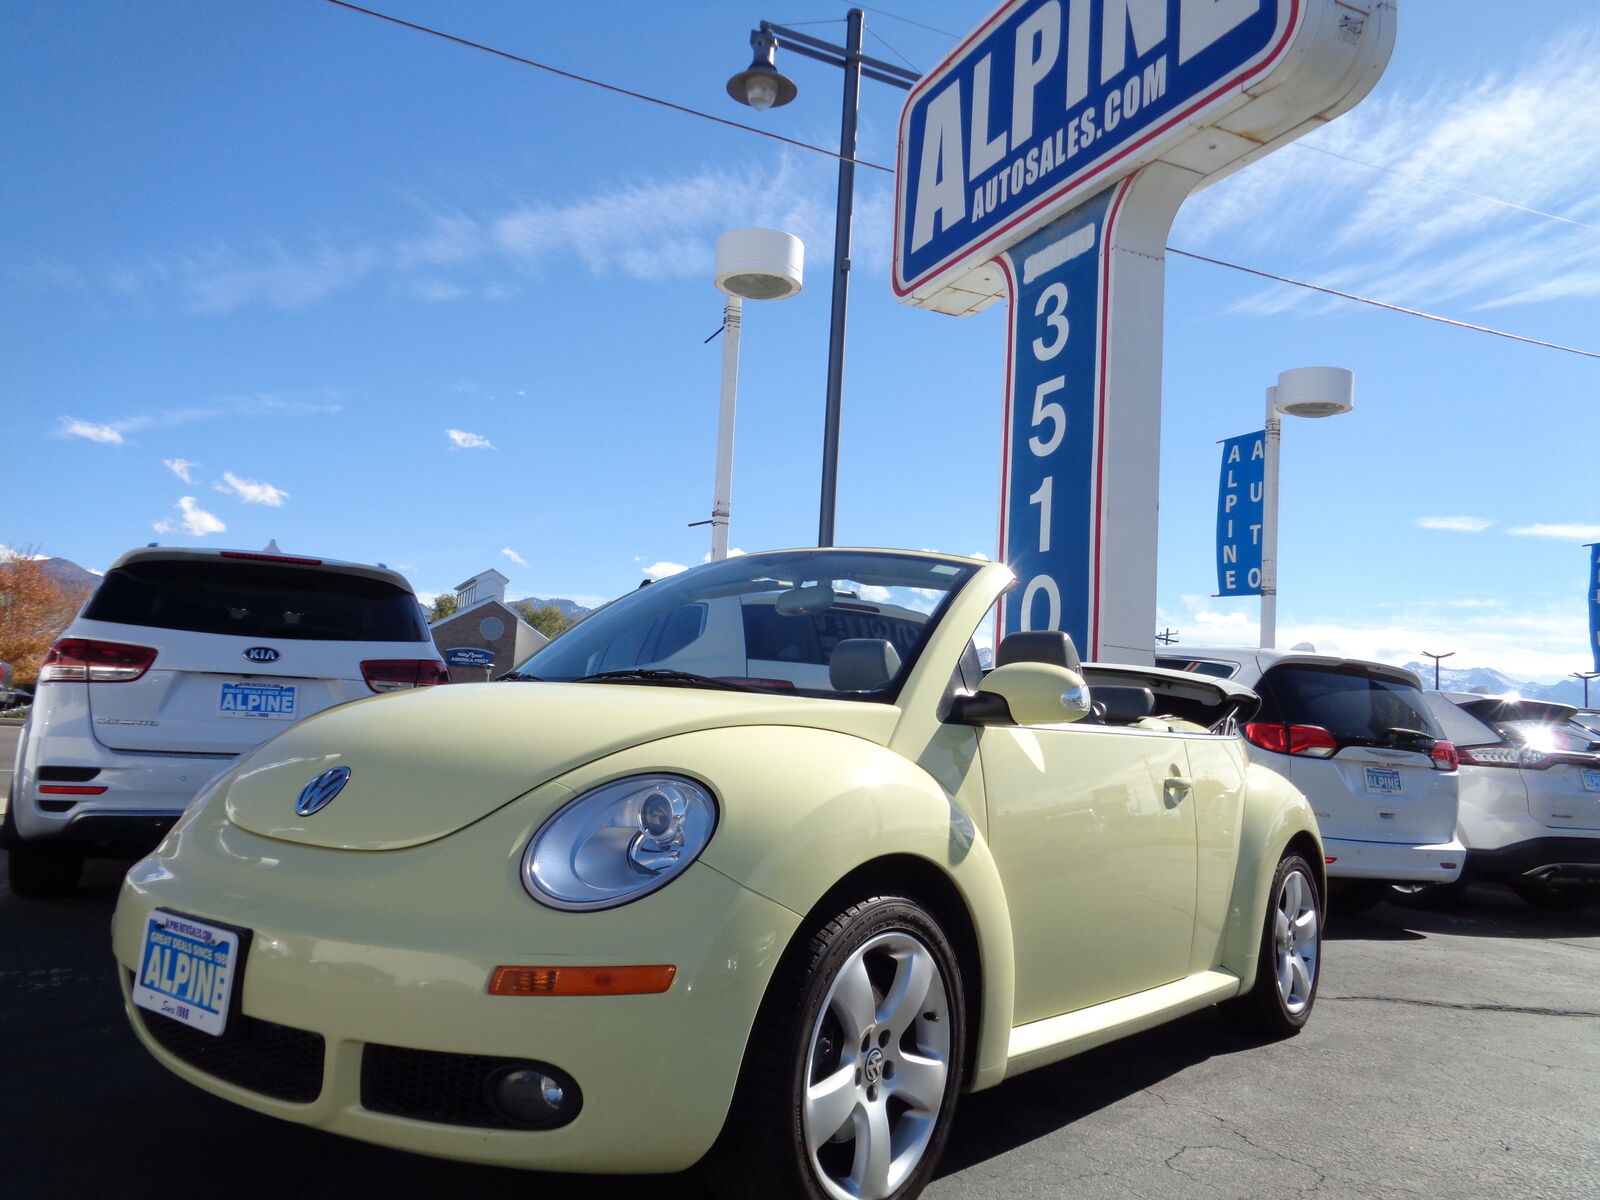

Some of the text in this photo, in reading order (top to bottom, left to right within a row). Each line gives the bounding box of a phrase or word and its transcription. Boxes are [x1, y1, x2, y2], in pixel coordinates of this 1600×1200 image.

[911, 0, 1260, 255] ALPIN
[971, 55, 1167, 224] AUTOSALES.COM
[1223, 444, 1241, 590] ALPINE
[1248, 439, 1265, 589] AUTO
[249, 649, 275, 660] KIA
[222, 694, 293, 712] ALPINE
[1367, 775, 1401, 791] ALPINE
[143, 945, 227, 1011] ALPINE
[151, 932, 171, 945] GREAT
[172, 937, 192, 954] DEALS
[193, 944, 214, 961] SINCE
